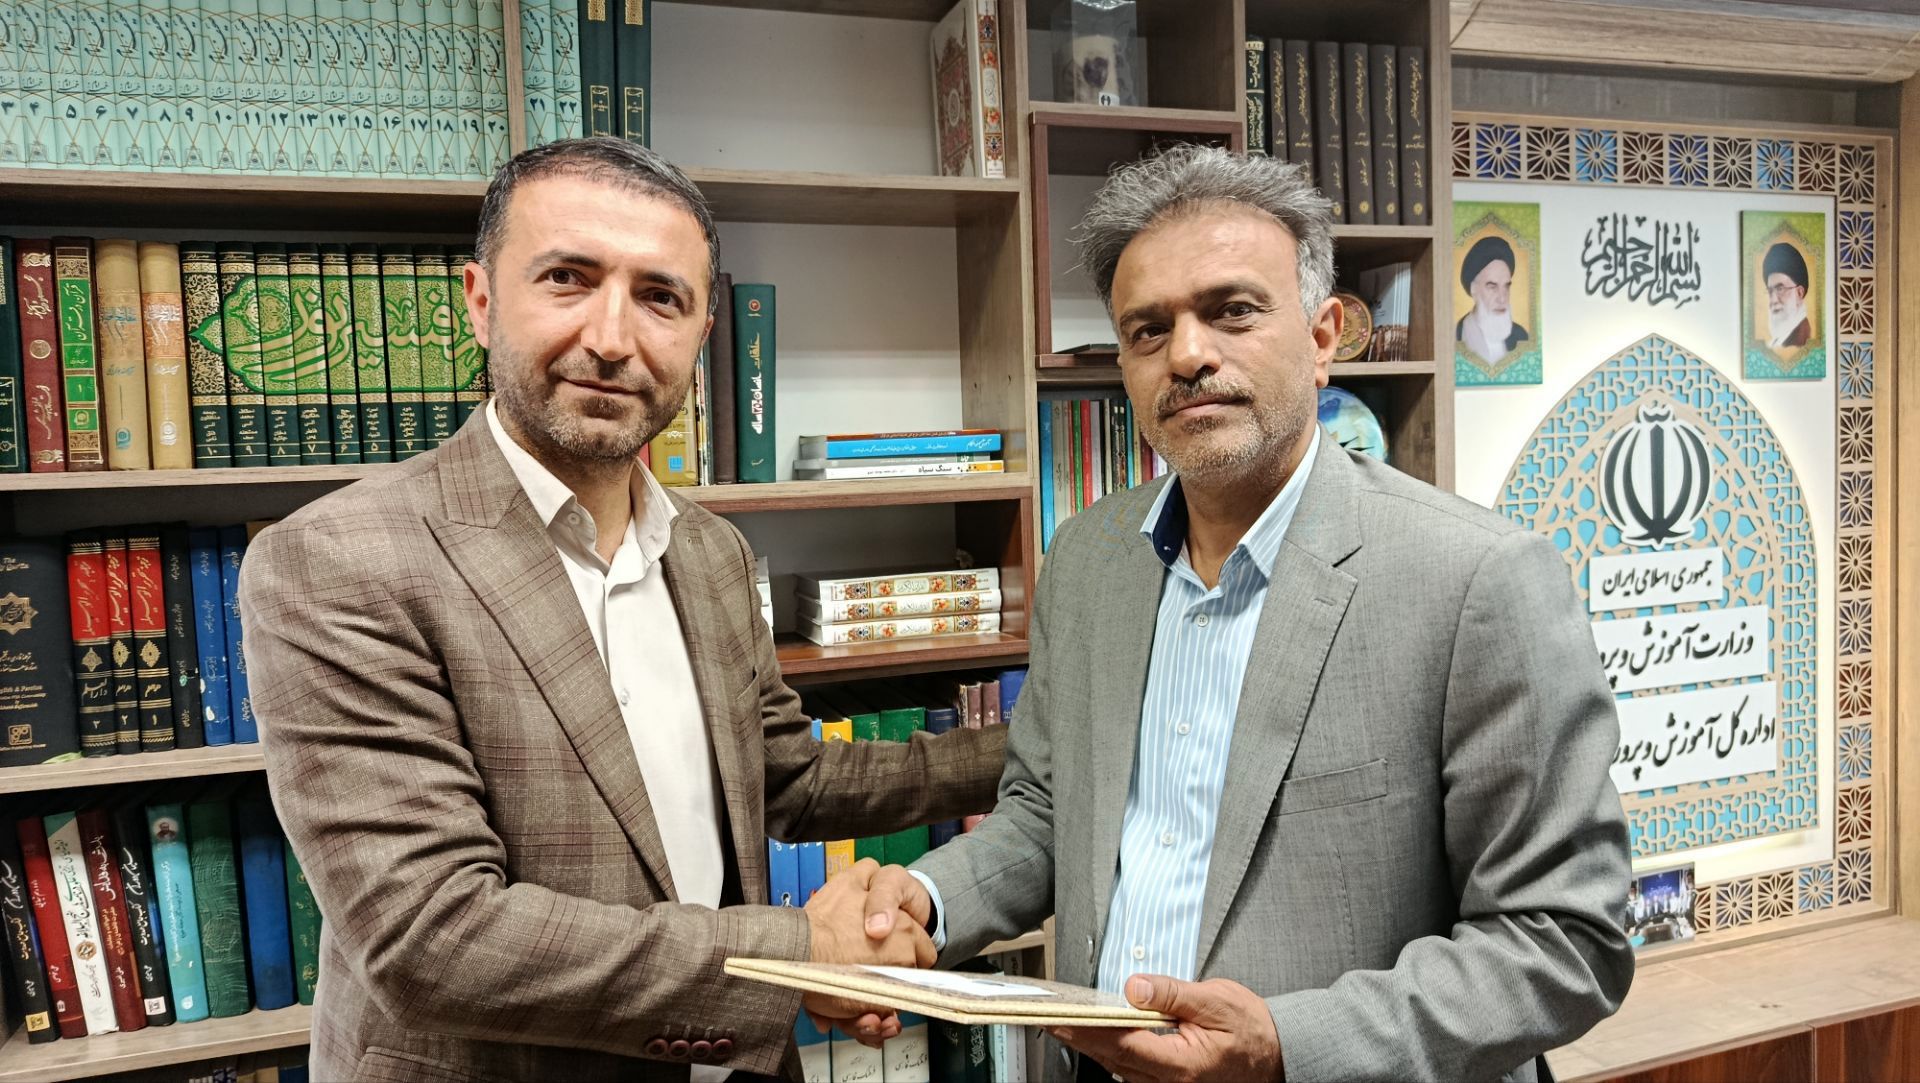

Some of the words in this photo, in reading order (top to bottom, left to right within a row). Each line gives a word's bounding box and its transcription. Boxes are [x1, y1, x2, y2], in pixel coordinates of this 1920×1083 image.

[1, 101, 14, 115] ۳
[29, 102, 40, 116] ۴
[66, 104, 77, 119] ۵
[96, 105, 107, 119] ۶
[529, 98, 546, 111] ۲۱
[559, 102, 577, 114] ۲۲
[126, 106, 138, 120] ۷
[159, 109, 171, 123] ۸
[185, 108, 194, 122] ۹
[214, 110, 233, 124] ۱۰
[244, 111, 261, 126] ۱۱
[270, 112, 289, 126] ۱۲
[299, 113, 319, 127] ۱۳
[328, 113, 348, 128] ۱۴
[355, 114, 374, 129] ۱۵
[383, 114, 401, 129] ۱۶
[410, 116, 428, 130] ۱۷
[436, 117, 454, 131] ۱۸
[463, 118, 480, 133] ۱۹
[488, 121, 505, 133] ۲۰
[64, 283, 87, 303] قرآن
[66, 306, 88, 341] قرآن
[1602, 567, 1635, 597] ایران
[1634, 567, 1669, 595] اسلامی
[1671, 559, 1713, 593] جمهوری
[1629, 620, 1700, 676] آموزش
[1692, 621, 1754, 660] وزارت
[1617, 649, 1629, 669] و
[1600, 647, 1620, 690] پرو
[93, 720, 101, 729] ۳
[121, 714, 129, 725] ۲
[1716, 695, 1749, 759] کل
[1740, 713, 1776, 746] اداره
[1652, 712, 1722, 766] آموزش
[1642, 742, 1653, 760] و
[1612, 740, 1643, 781] پرور
